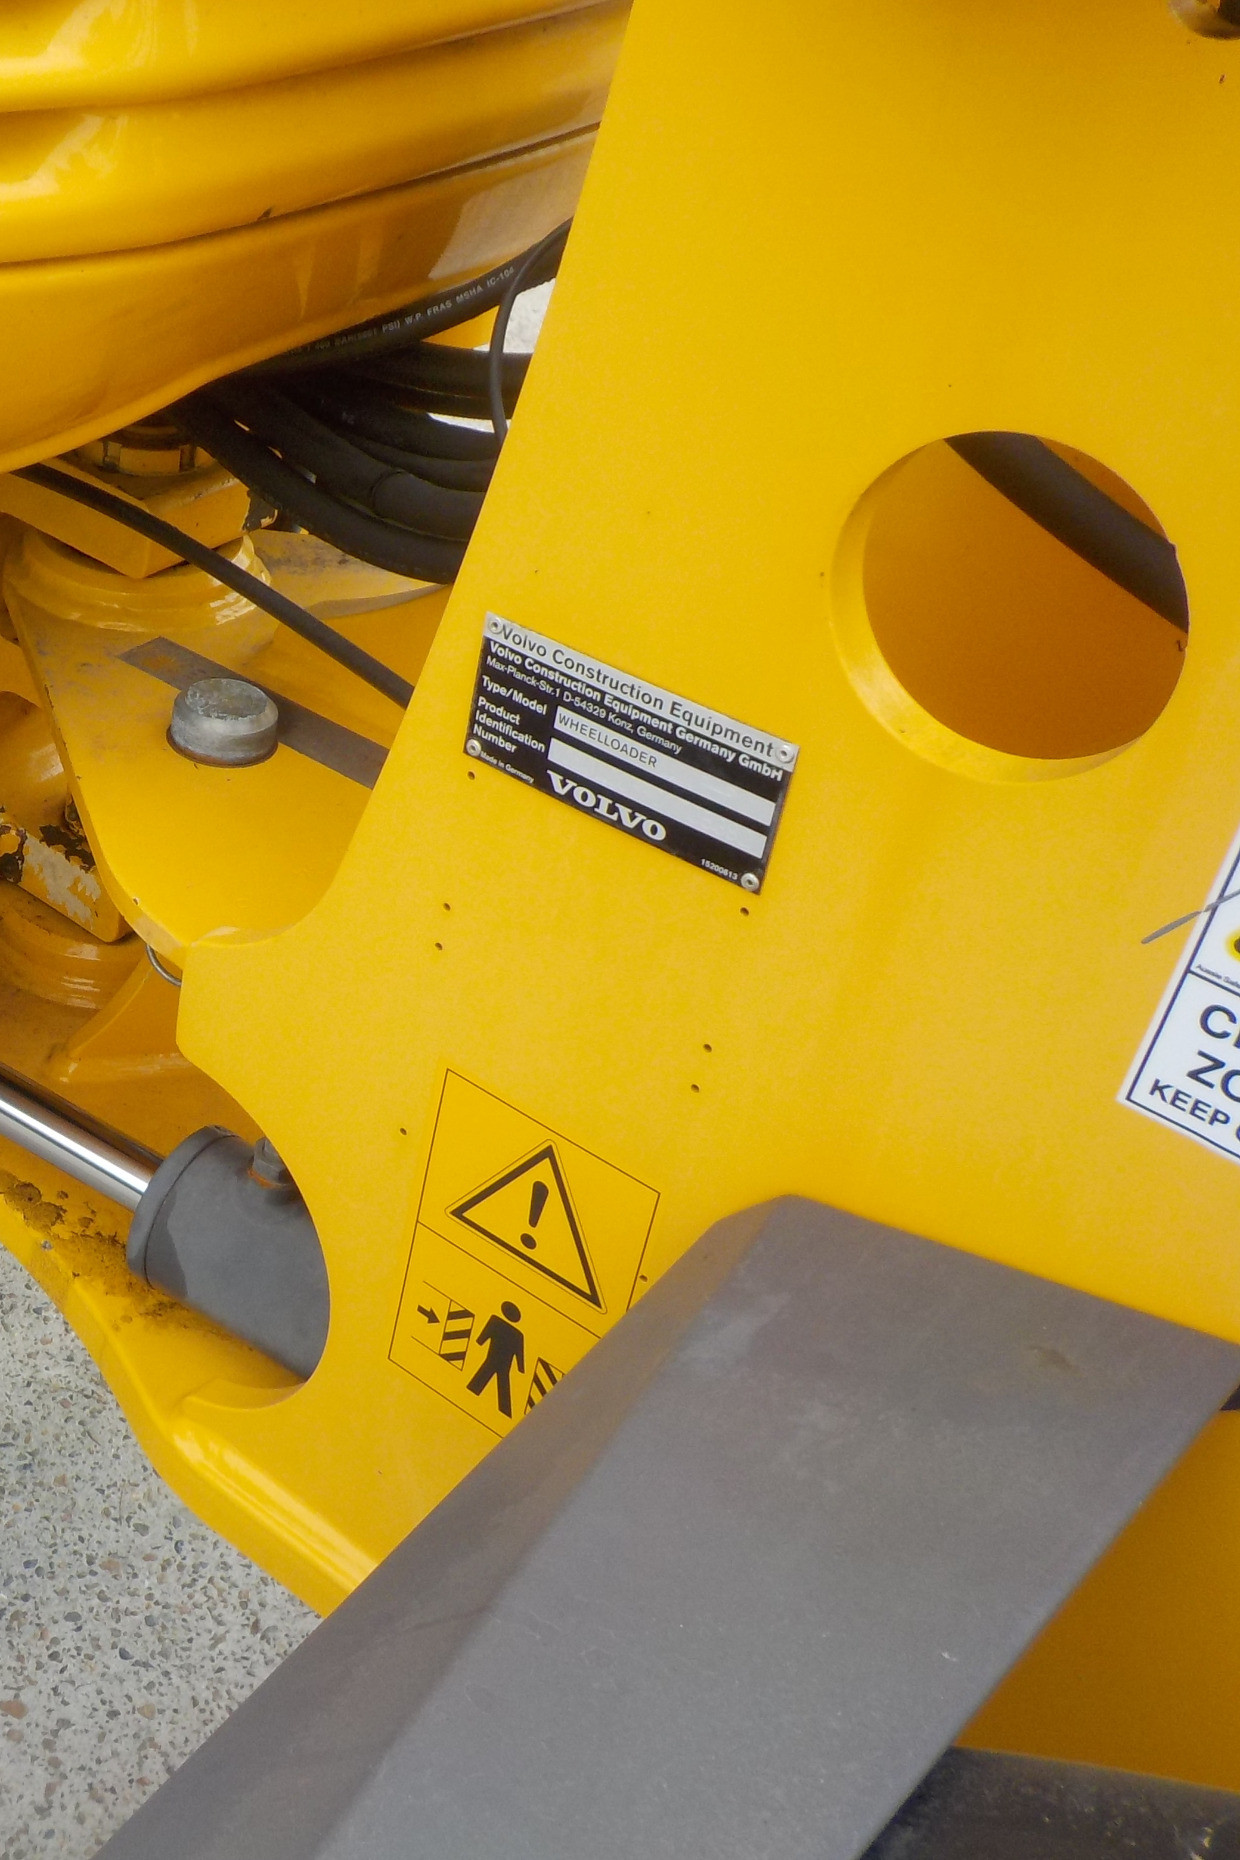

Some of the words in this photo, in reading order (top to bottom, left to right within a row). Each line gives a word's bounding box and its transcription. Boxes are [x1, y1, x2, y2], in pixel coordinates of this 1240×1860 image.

[427, 299, 452, 317] FRAS
[456, 284, 483, 302] MSHA
[477, 696, 520, 726] Product
[481, 674, 547, 716] Type/Model
[490, 640, 522, 664] Volvo
[524, 657, 601, 701] Construction
[603, 694, 673, 735] Equipment
[675, 726, 736, 764] Germany
[738, 752, 783, 782] GmbH
[500, 624, 547, 658] Volvo
[552, 649, 664, 711] Construction
[669, 701, 774, 758] Equipment
[473, 723, 517, 754] Number
[475, 710, 545, 753] Identification
[558, 712, 658, 769] WHEELLOADER
[562, 691, 607, 719] D-54329
[636, 725, 682, 756] Germany
[505, 763, 534, 785] Germany
[546, 769, 667, 841] VOLVO
[1149, 1078, 1231, 1126] KEEP
